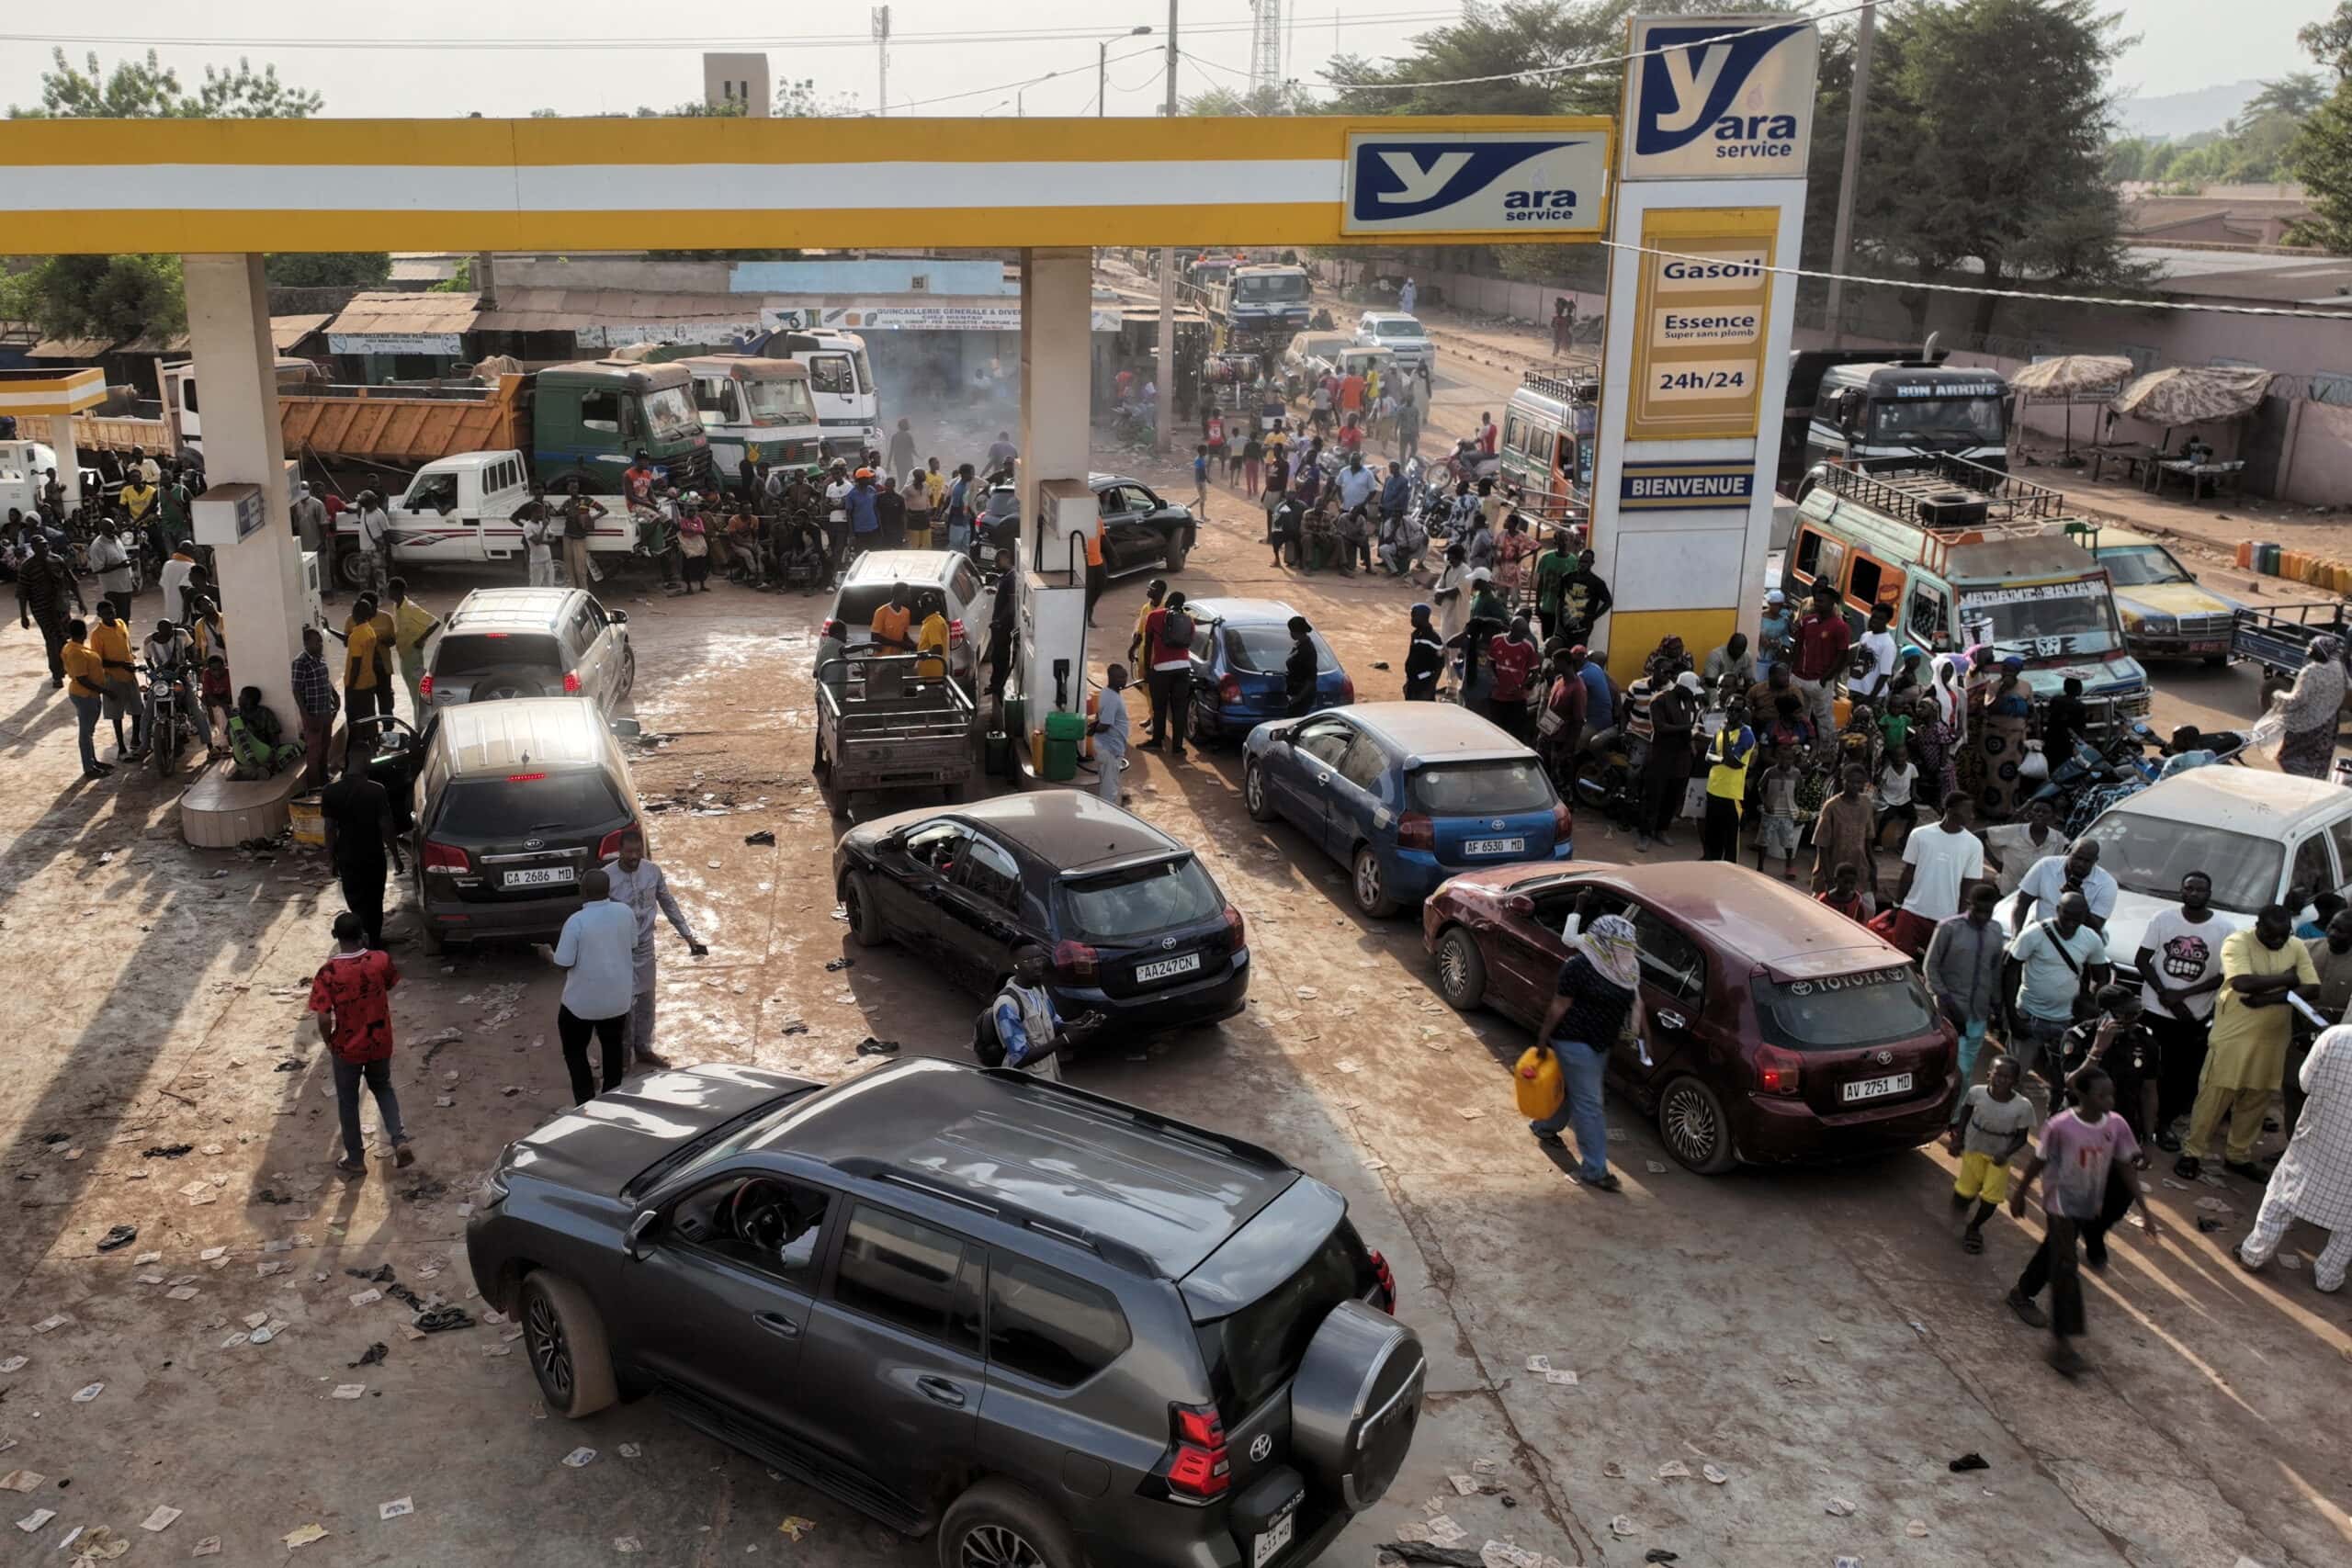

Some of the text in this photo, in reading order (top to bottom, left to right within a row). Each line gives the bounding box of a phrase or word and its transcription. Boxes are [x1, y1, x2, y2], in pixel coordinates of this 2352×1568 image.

[1715, 141, 1792, 158] service
[1505, 209, 1573, 221] service
[1664, 258, 1760, 279] Gasoil
[1665, 315, 1755, 330] Essence
[1665, 331, 1694, 340] Super
[1721, 329, 1755, 339] plomb
[1659, 372, 1744, 389] 24h/24
[1897, 386, 1930, 397] BON
[1631, 475, 1746, 496] BIENVENUE
[1467, 840, 1522, 852] AF 6530 MD
[506, 870, 571, 884] CA 2686 MD
[1145, 957, 1193, 978] AA247CN
[1815, 972, 1885, 991] TOYOTA
[1847, 1075, 1910, 1099] AV 2751 MD
